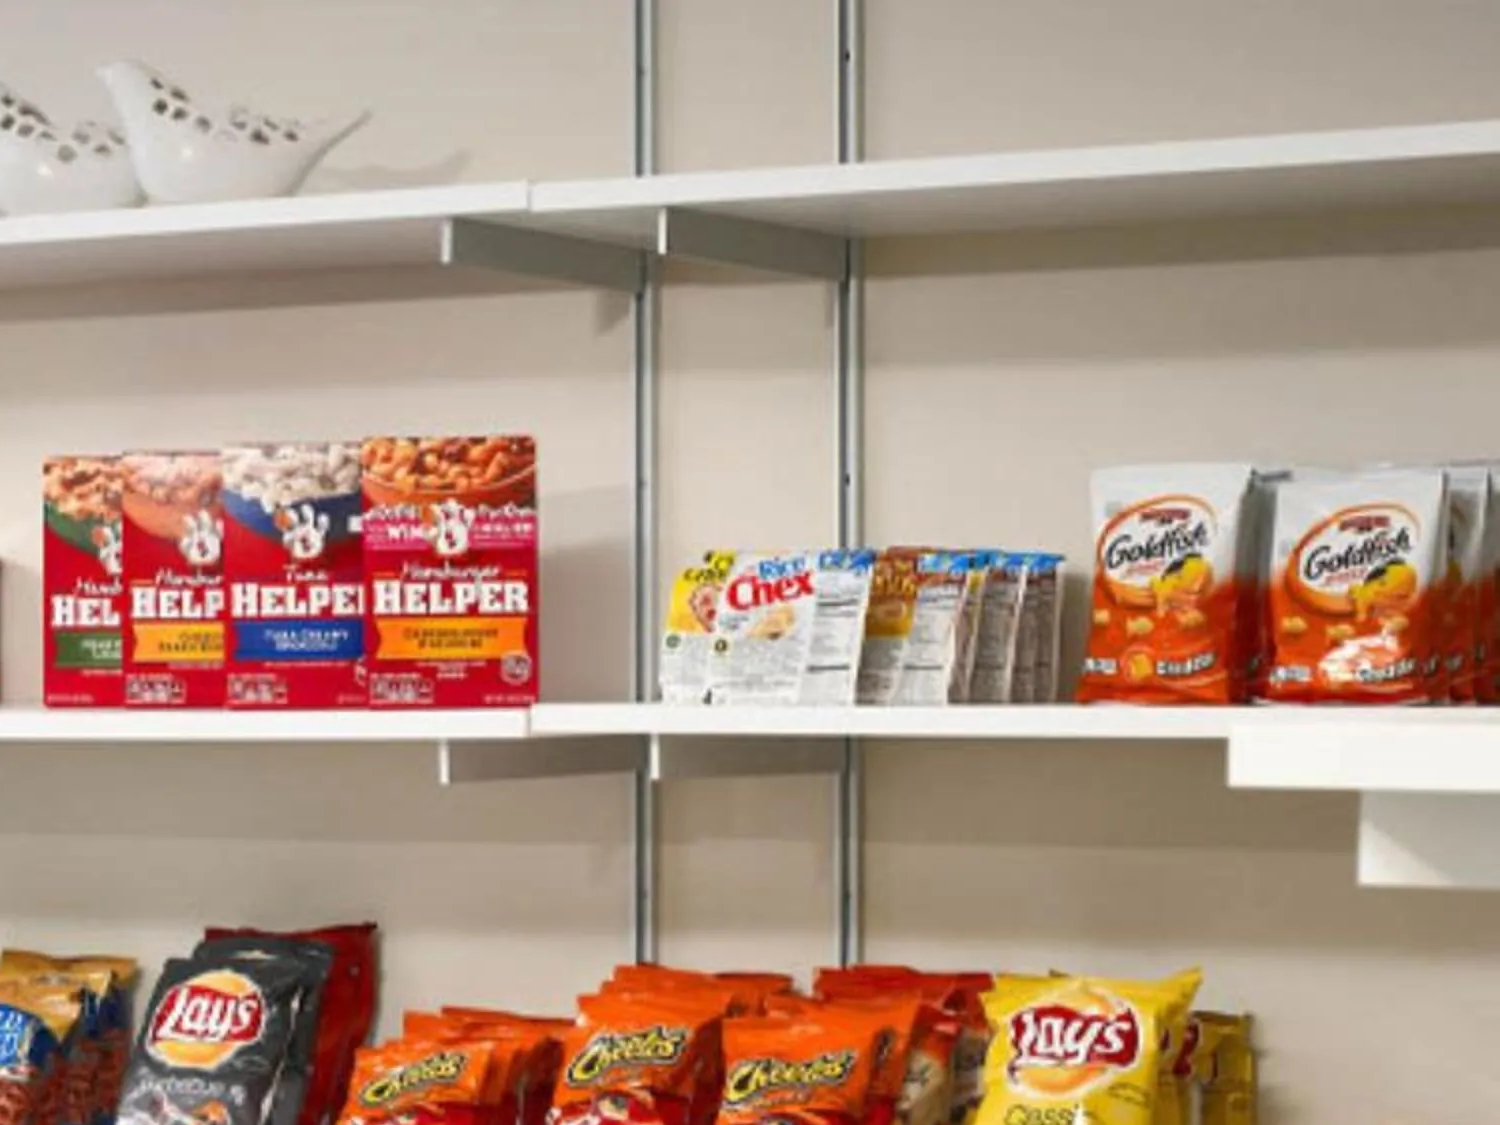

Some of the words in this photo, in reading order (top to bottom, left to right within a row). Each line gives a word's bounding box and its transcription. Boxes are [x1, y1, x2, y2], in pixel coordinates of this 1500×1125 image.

[1105, 522, 1209, 569] Goldfish
[1303, 527, 1413, 580] Goldfish
[373, 579, 529, 617] HELPER
[726, 571, 815, 612] Chex
[567, 1026, 688, 1086] Cheetos
[726, 1050, 857, 1105] Cheetos
